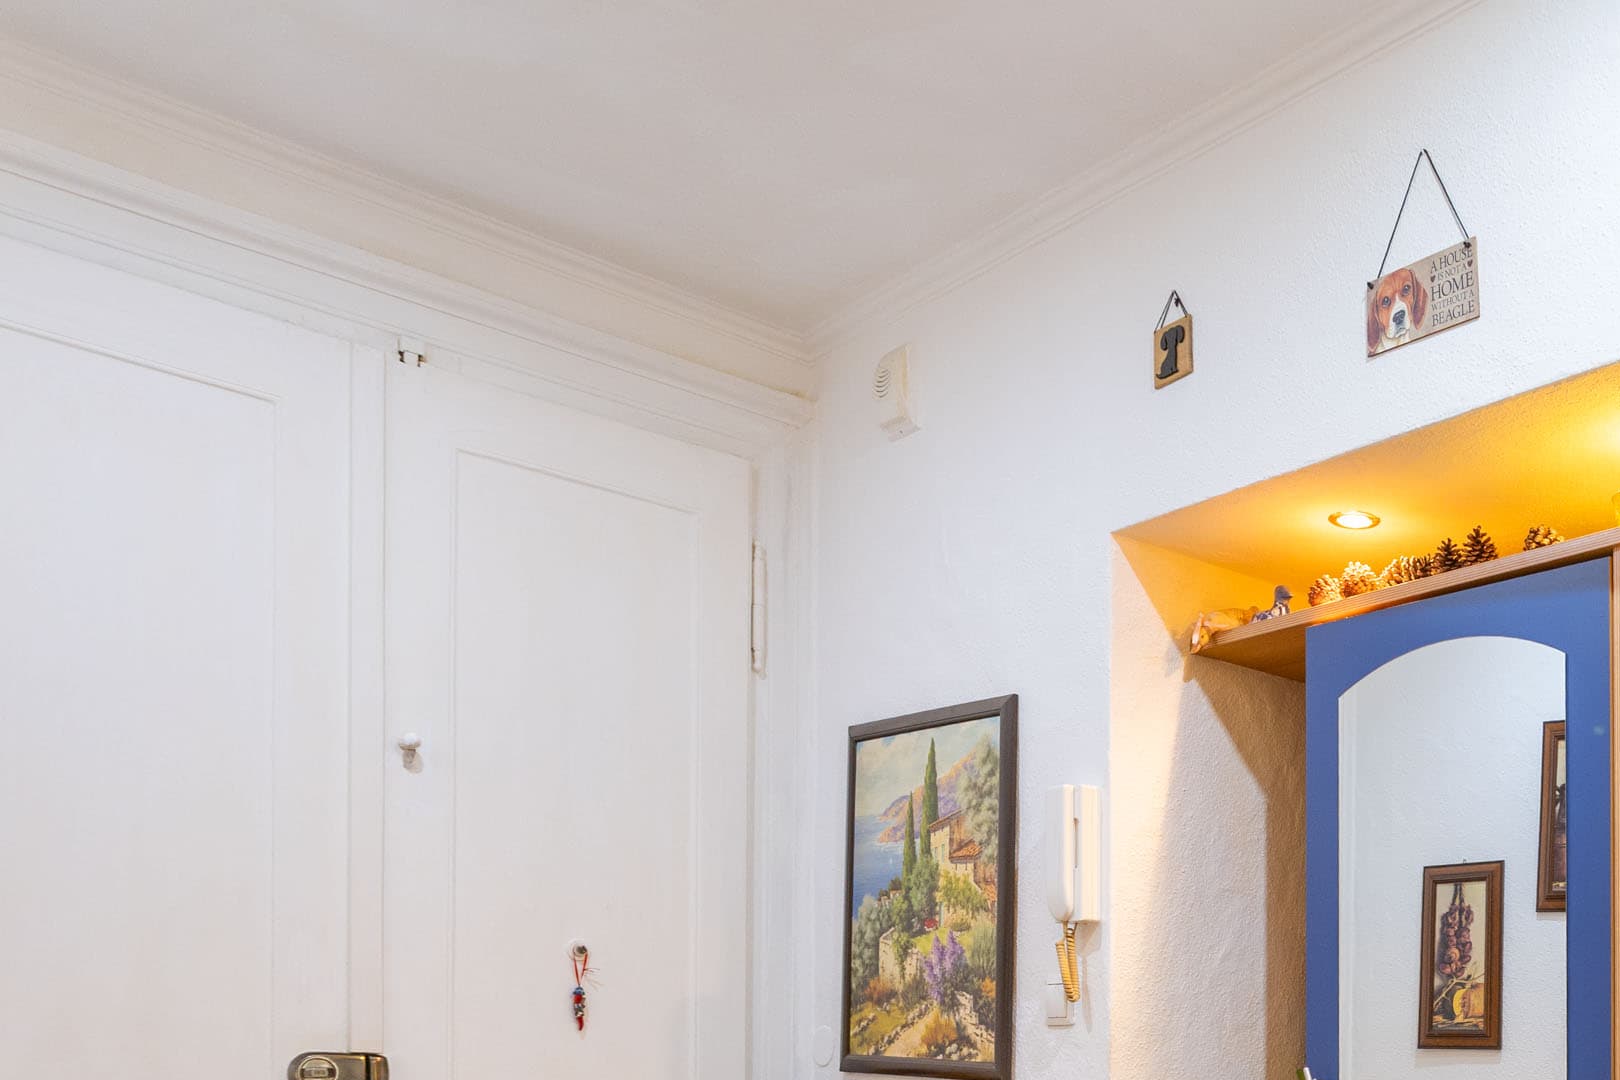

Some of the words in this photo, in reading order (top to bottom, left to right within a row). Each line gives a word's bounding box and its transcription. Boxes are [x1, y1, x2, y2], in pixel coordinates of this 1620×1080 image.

[1430, 260, 1437, 274] A
[1439, 248, 1473, 270] HOUSE
[1438, 272, 1444, 280] IS
[1445, 264, 1460, 279] NOT
[1462, 262, 1467, 270] A
[1431, 270, 1474, 302] HOME
[1431, 292, 1468, 312] WITHOUT
[1470, 289, 1474, 297] A
[1432, 299, 1475, 327] BEAGLE
